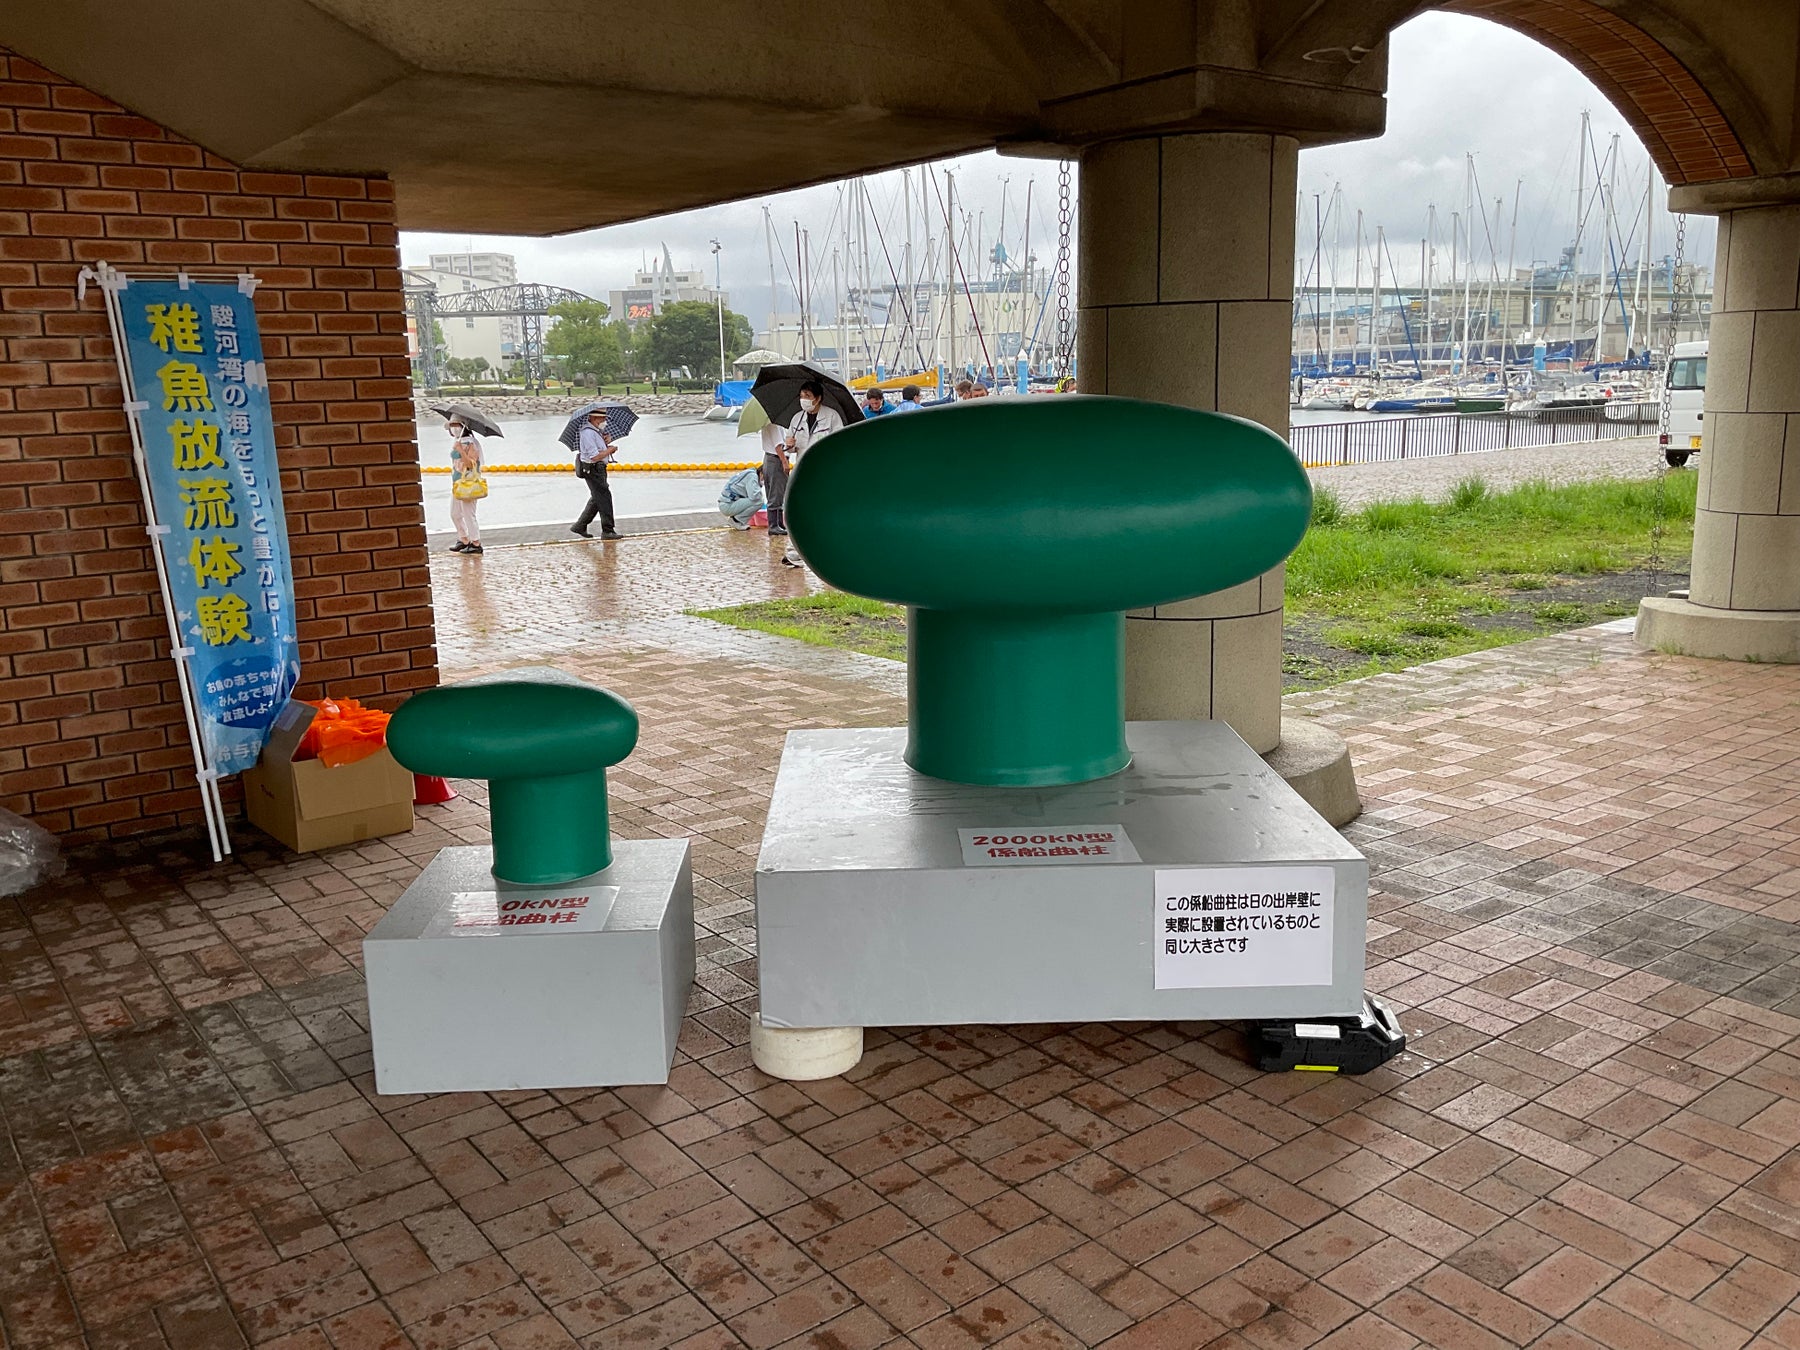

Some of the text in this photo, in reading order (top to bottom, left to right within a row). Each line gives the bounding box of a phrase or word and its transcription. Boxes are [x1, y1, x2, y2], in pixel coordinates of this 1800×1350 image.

[145, 302, 253, 646] 稚魚放流体験
[972, 833, 1116, 845] 2000kN型
[987, 845, 1110, 857] 係船曲柱
[1166, 892, 1320, 911] この係船曲柱は日の出岸壁に
[1165, 913, 1320, 933] 実際に設置されているものと
[1165, 937, 1249, 954] 同じ大きさです
